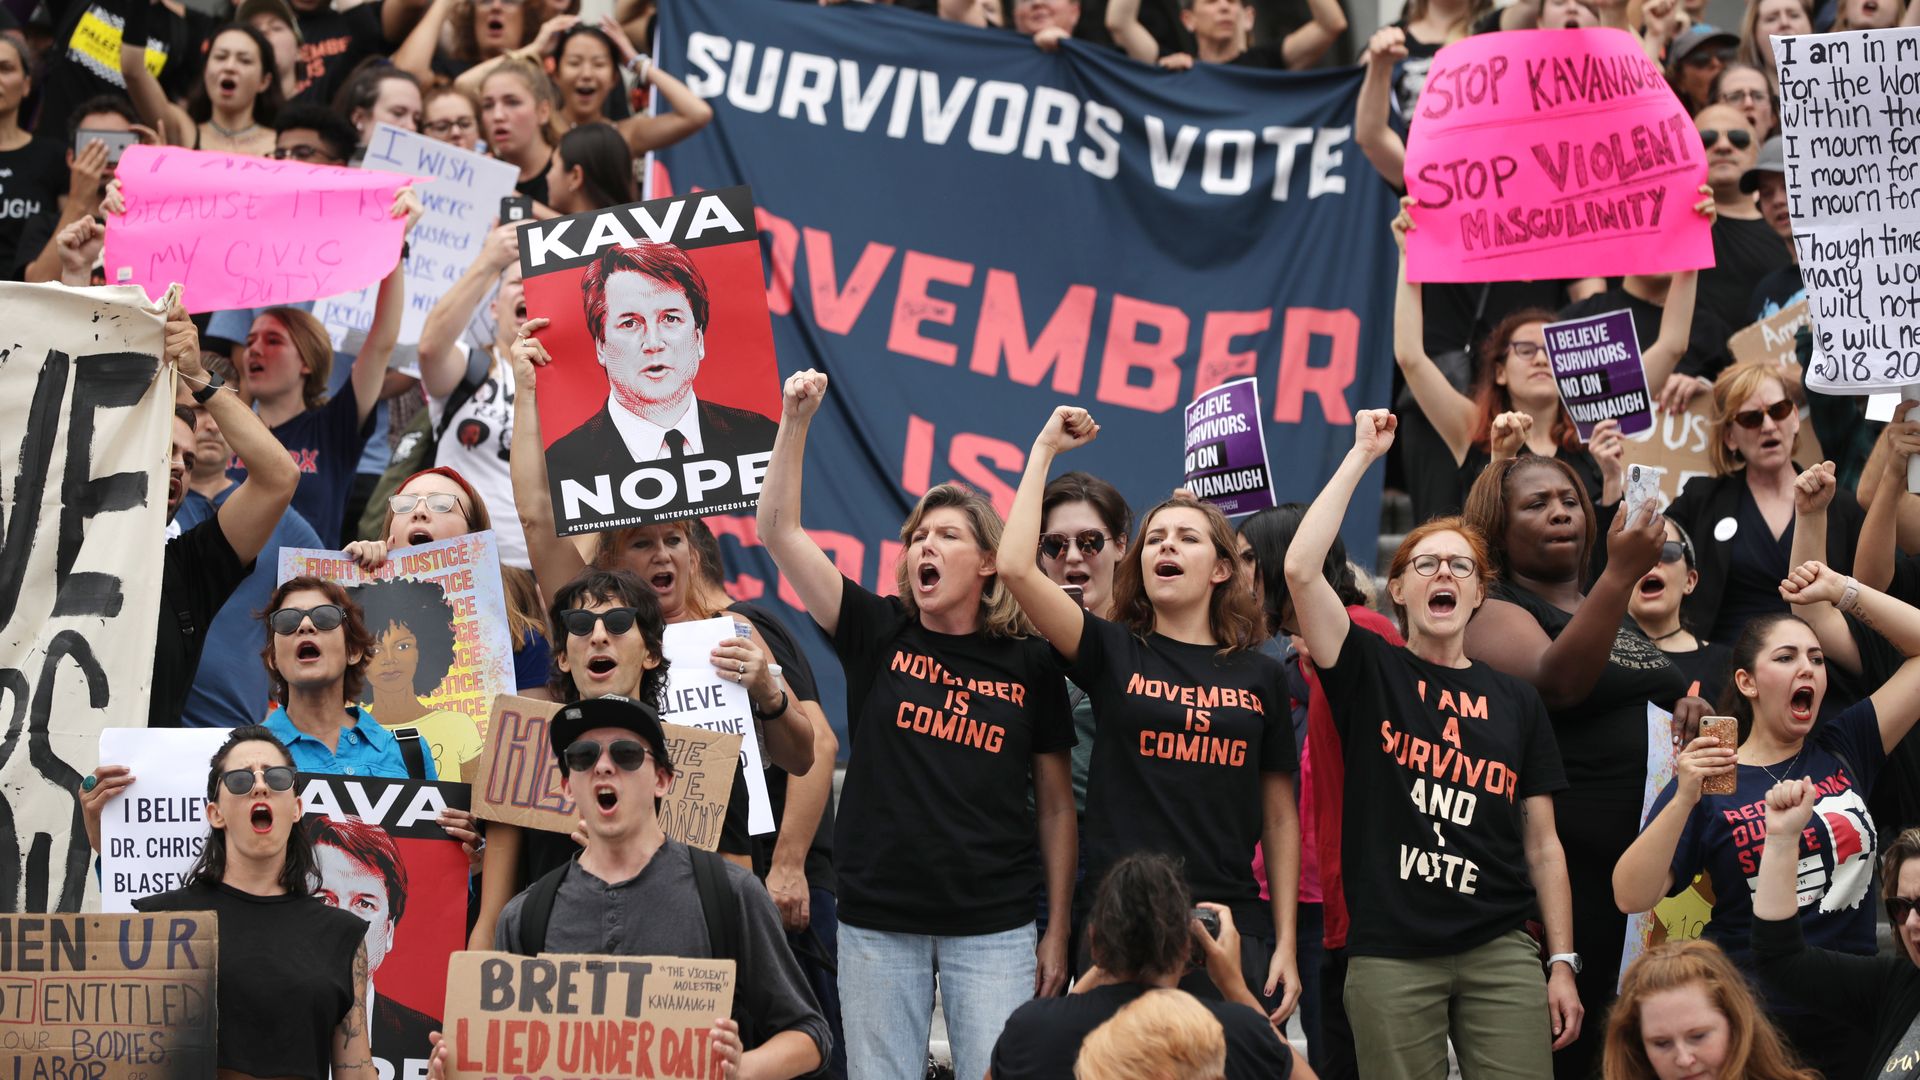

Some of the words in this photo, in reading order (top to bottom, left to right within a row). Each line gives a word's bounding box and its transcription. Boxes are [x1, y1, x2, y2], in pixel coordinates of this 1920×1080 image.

[1781, 38, 1797, 65] I
[1810, 41, 1850, 64] am
[1862, 33, 1885, 63] in
[1422, 56, 1509, 119] STOP
[1526, 54, 1668, 111] KAVANAUGH
[1780, 67, 1820, 101] for
[1827, 66, 1871, 101] the
[686, 31, 1122, 181] SURVIVORS
[1145, 115, 1351, 202] VOTE
[1783, 97, 1871, 128] within
[371, 127, 409, 166] I
[1418, 155, 1518, 209] STOP
[1531, 113, 1691, 193] VIOLENT
[1786, 136, 1800, 159] I
[1810, 135, 1882, 158] mourn
[1788, 165, 1801, 189] I
[1811, 162, 1881, 187] mourn
[1887, 155, 1919, 182] for
[120, 190, 258, 227] BECAUSE
[293, 189, 335, 218] IT
[358, 187, 388, 222] IS
[1460, 185, 1667, 251] MASCULINITY
[1790, 194, 1804, 218] I
[1812, 189, 1881, 217] mourn
[527, 194, 744, 268] KAVA
[150, 236, 200, 285] MY
[225, 239, 342, 277] CIVIC
[1794, 228, 1874, 269] Though
[240, 272, 332, 305] DUTY
[653, 161, 1361, 427] OVEMBER
[1802, 267, 1863, 299] many
[1820, 288, 1869, 318] will
[1880, 286, 1920, 318] not
[1550, 333, 1557, 351] I
[1557, 323, 1610, 350] BELIEVE
[1843, 319, 1892, 350] will
[1555, 342, 1631, 373] SURVIVORS.
[1815, 352, 1871, 381] 2018
[1561, 377, 1580, 398] NO
[1583, 373, 1603, 395] ON
[1569, 392, 1645, 422] KAVANAUGH
[1198, 445, 1219, 468] ON
[560, 450, 774, 520] NOPE
[1184, 468, 1263, 498] AVANAUGH
[568, 516, 642, 532] #STOPKAVANAUGH
[654, 500, 760, 521] UNITEFORJUSTICE2018.CO
[305, 557, 354, 580] FIGHT
[400, 543, 471, 576] JUSTICE
[666, 684, 727, 714] LIEVE
[944, 690, 970, 716] IS
[1126, 672, 1265, 716] NOVEMBER
[1417, 680, 1427, 703] I
[1437, 689, 1488, 720] AM
[896, 701, 1006, 754] COMING
[1184, 708, 1211, 733] IS
[1442, 716, 1462, 750] A
[1140, 730, 1248, 767] COMING
[1380, 720, 1519, 805] SURVIVOR
[125, 798, 129, 823] I
[138, 797, 207, 823] BELIE
[300, 778, 452, 828] AVA
[1410, 778, 1477, 827] AND
[110, 837, 140, 858] DR.
[146, 836, 209, 858] CHRIS
[1732, 819, 1767, 848] OU
[1400, 844, 1480, 895] VOTE
[119, 917, 154, 970] U
[167, 917, 199, 970] R
[480, 958, 652, 1018] BRETT
[687, 967, 728, 980] VIOLENT
[649, 994, 715, 1012] KAVANAUGH
[673, 981, 729, 993] MOLESTER"
[44, 983, 204, 1026] ENTITLED
[4, 1031, 50, 1049] OUR
[456, 1017, 550, 1075] LIED
[556, 1019, 655, 1080] UNDER
